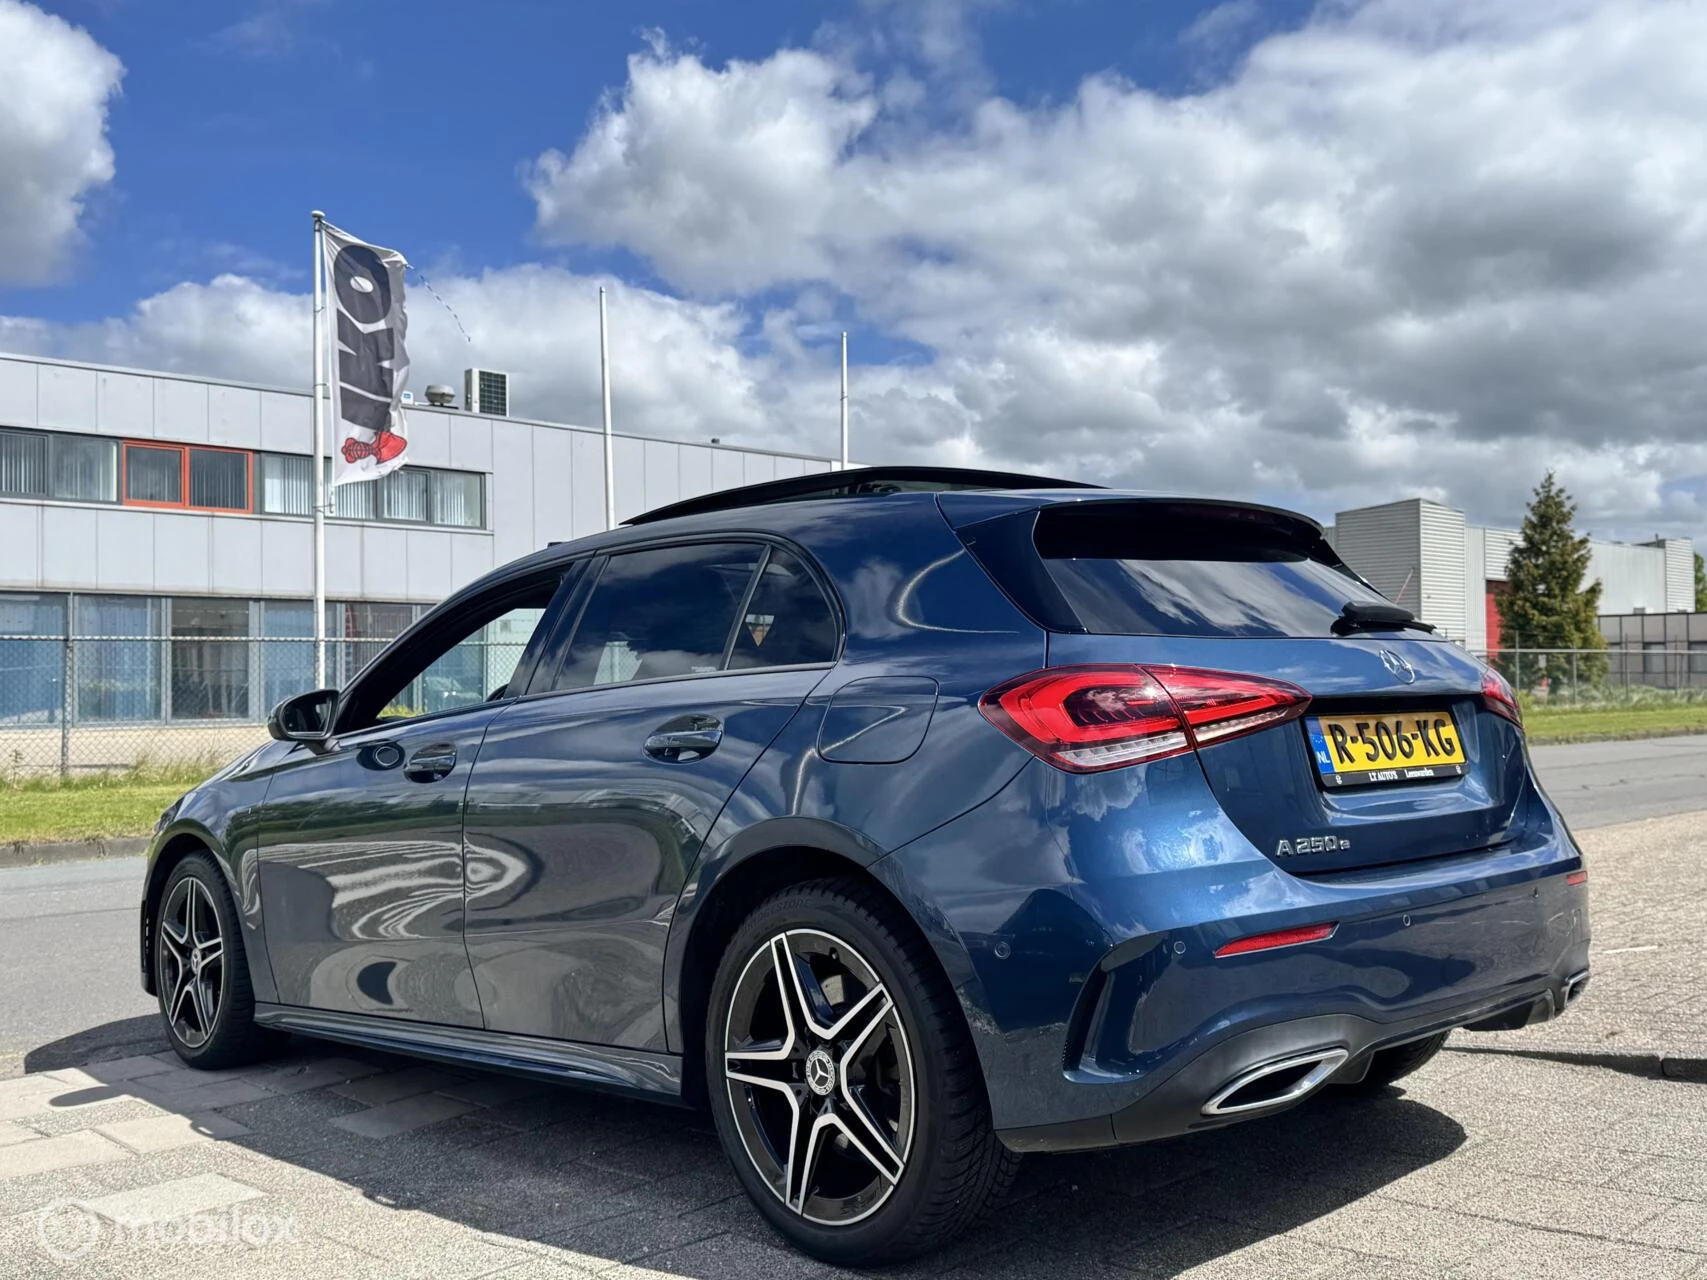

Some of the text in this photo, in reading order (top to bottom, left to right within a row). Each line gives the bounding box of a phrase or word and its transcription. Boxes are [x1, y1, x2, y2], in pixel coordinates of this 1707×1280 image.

[334, 244, 395, 434] IKO
[1317, 751, 1331, 764] NL
[1328, 718, 1456, 765] R-506-KG
